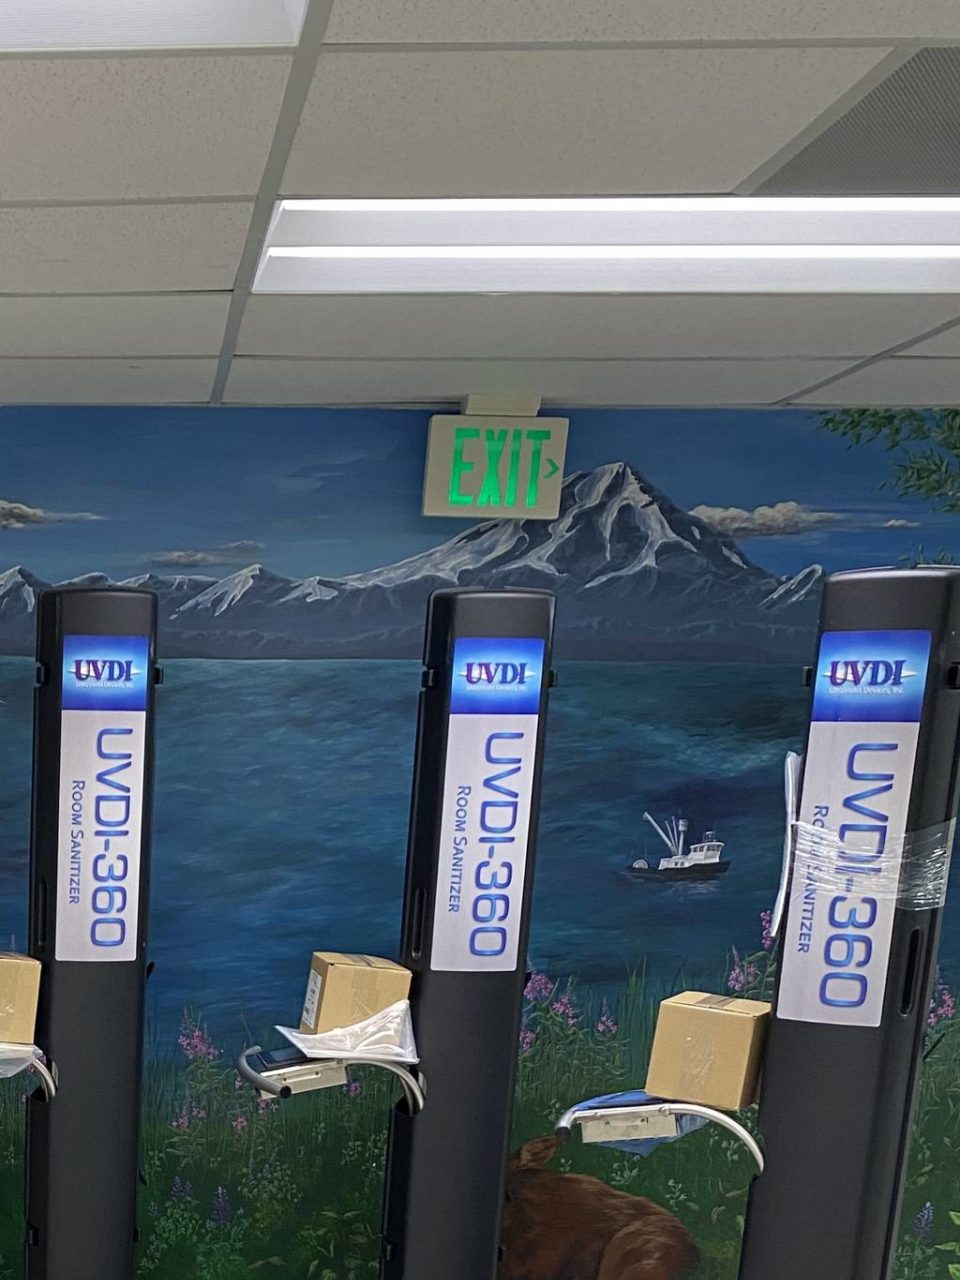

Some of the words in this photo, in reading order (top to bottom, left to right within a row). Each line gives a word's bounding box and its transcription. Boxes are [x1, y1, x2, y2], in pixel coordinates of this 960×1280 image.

[448, 427, 552, 508] EXIT
[74, 659, 133, 681] UVDI
[466, 662, 528, 685] UVDI
[830, 660, 907, 686] UVDI
[90, 728, 134, 948] UVDI-360
[469, 732, 525, 957] UVDI-360
[818, 743, 898, 1008] UVDI-360
